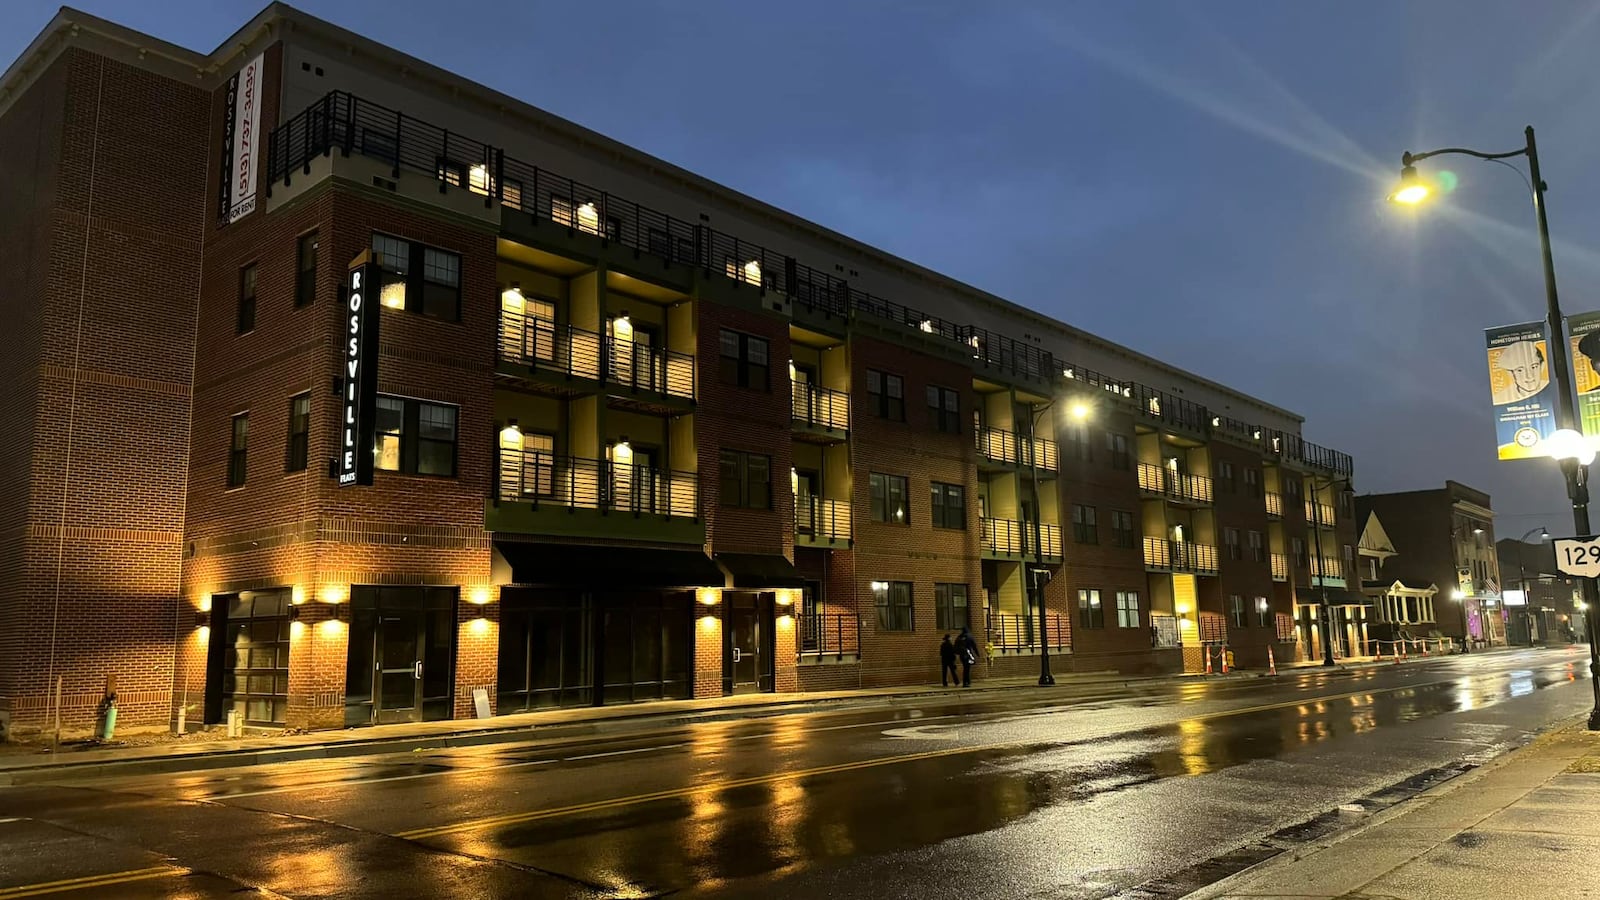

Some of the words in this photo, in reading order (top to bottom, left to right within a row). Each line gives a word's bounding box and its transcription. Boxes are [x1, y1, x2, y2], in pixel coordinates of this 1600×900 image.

[222, 77, 236, 214] ROSSVILLE
[239, 152, 249, 197] (513)
[230, 206, 241, 219] FOR
[241, 199, 255, 215] RENT
[1490, 335, 1520, 345] HOMETOWN
[344, 271, 362, 470] ROSSVILLE
[339, 472, 356, 483] FLATS
[1564, 545, 1600, 566] 129
